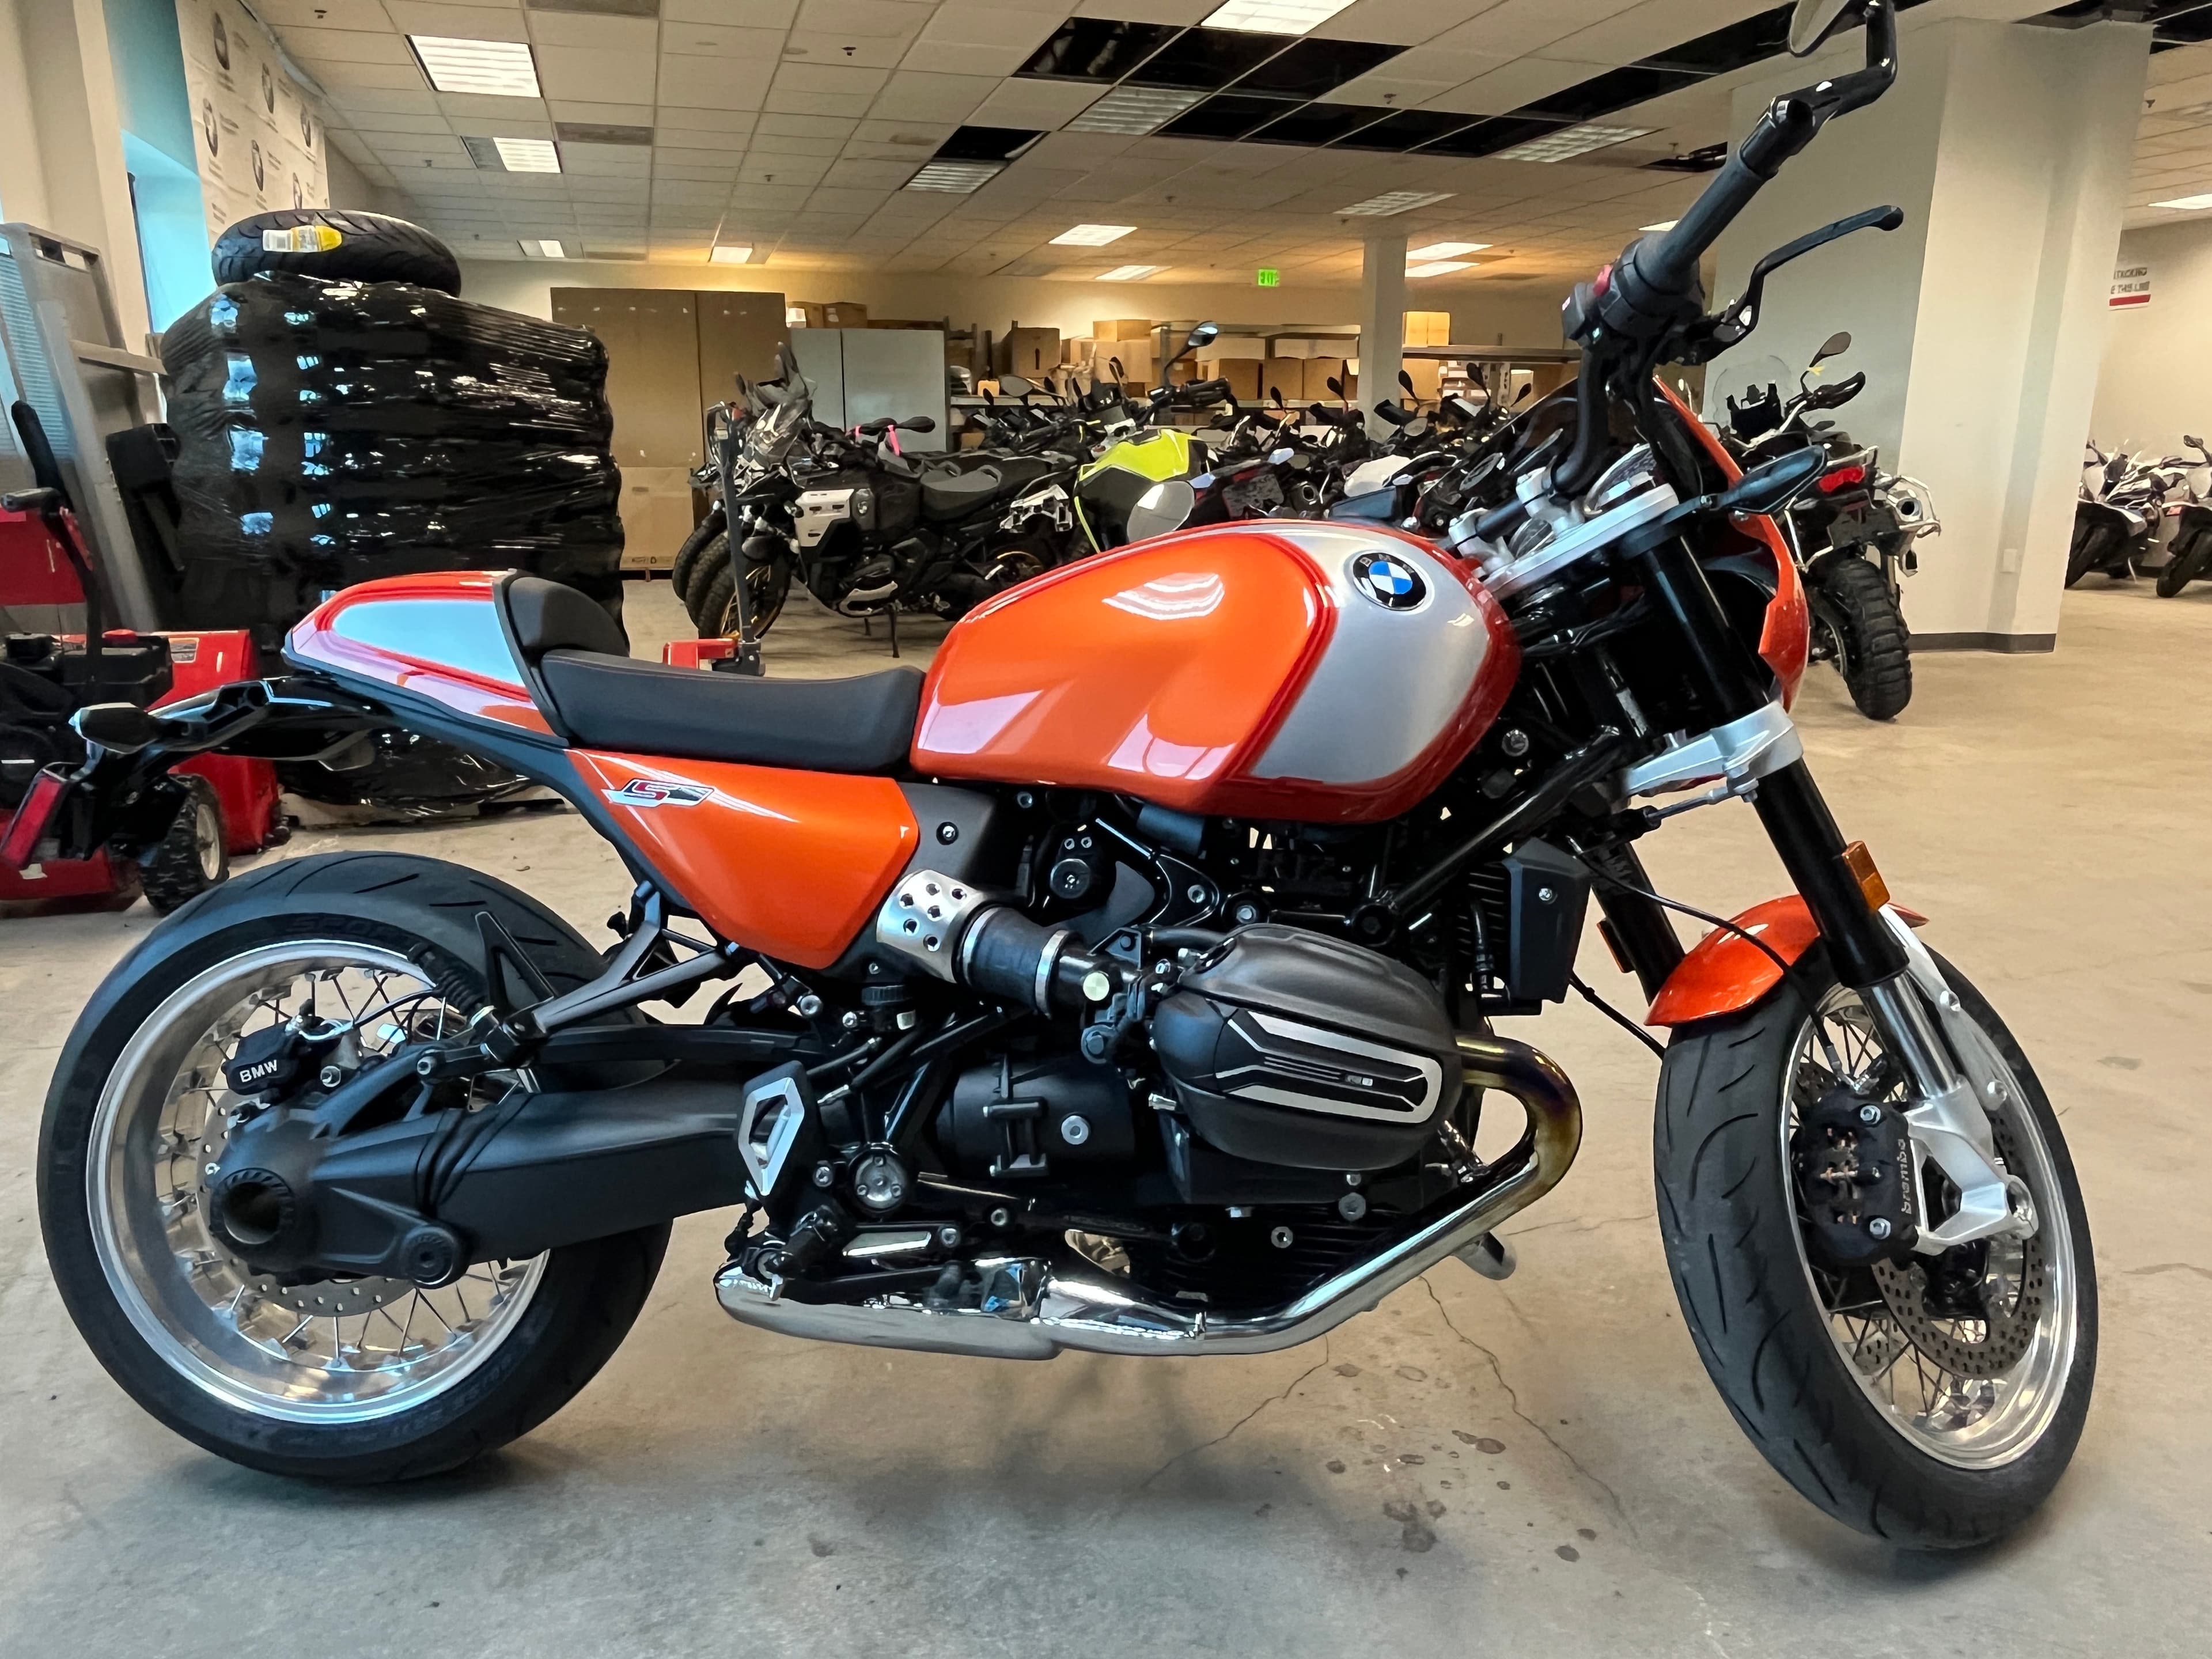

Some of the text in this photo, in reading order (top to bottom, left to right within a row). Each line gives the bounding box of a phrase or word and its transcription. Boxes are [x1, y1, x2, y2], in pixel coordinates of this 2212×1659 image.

[1359, 553, 1415, 574] BMW
[239, 1059, 278, 1083] BMW
[1896, 1138, 1912, 1215] brembo
